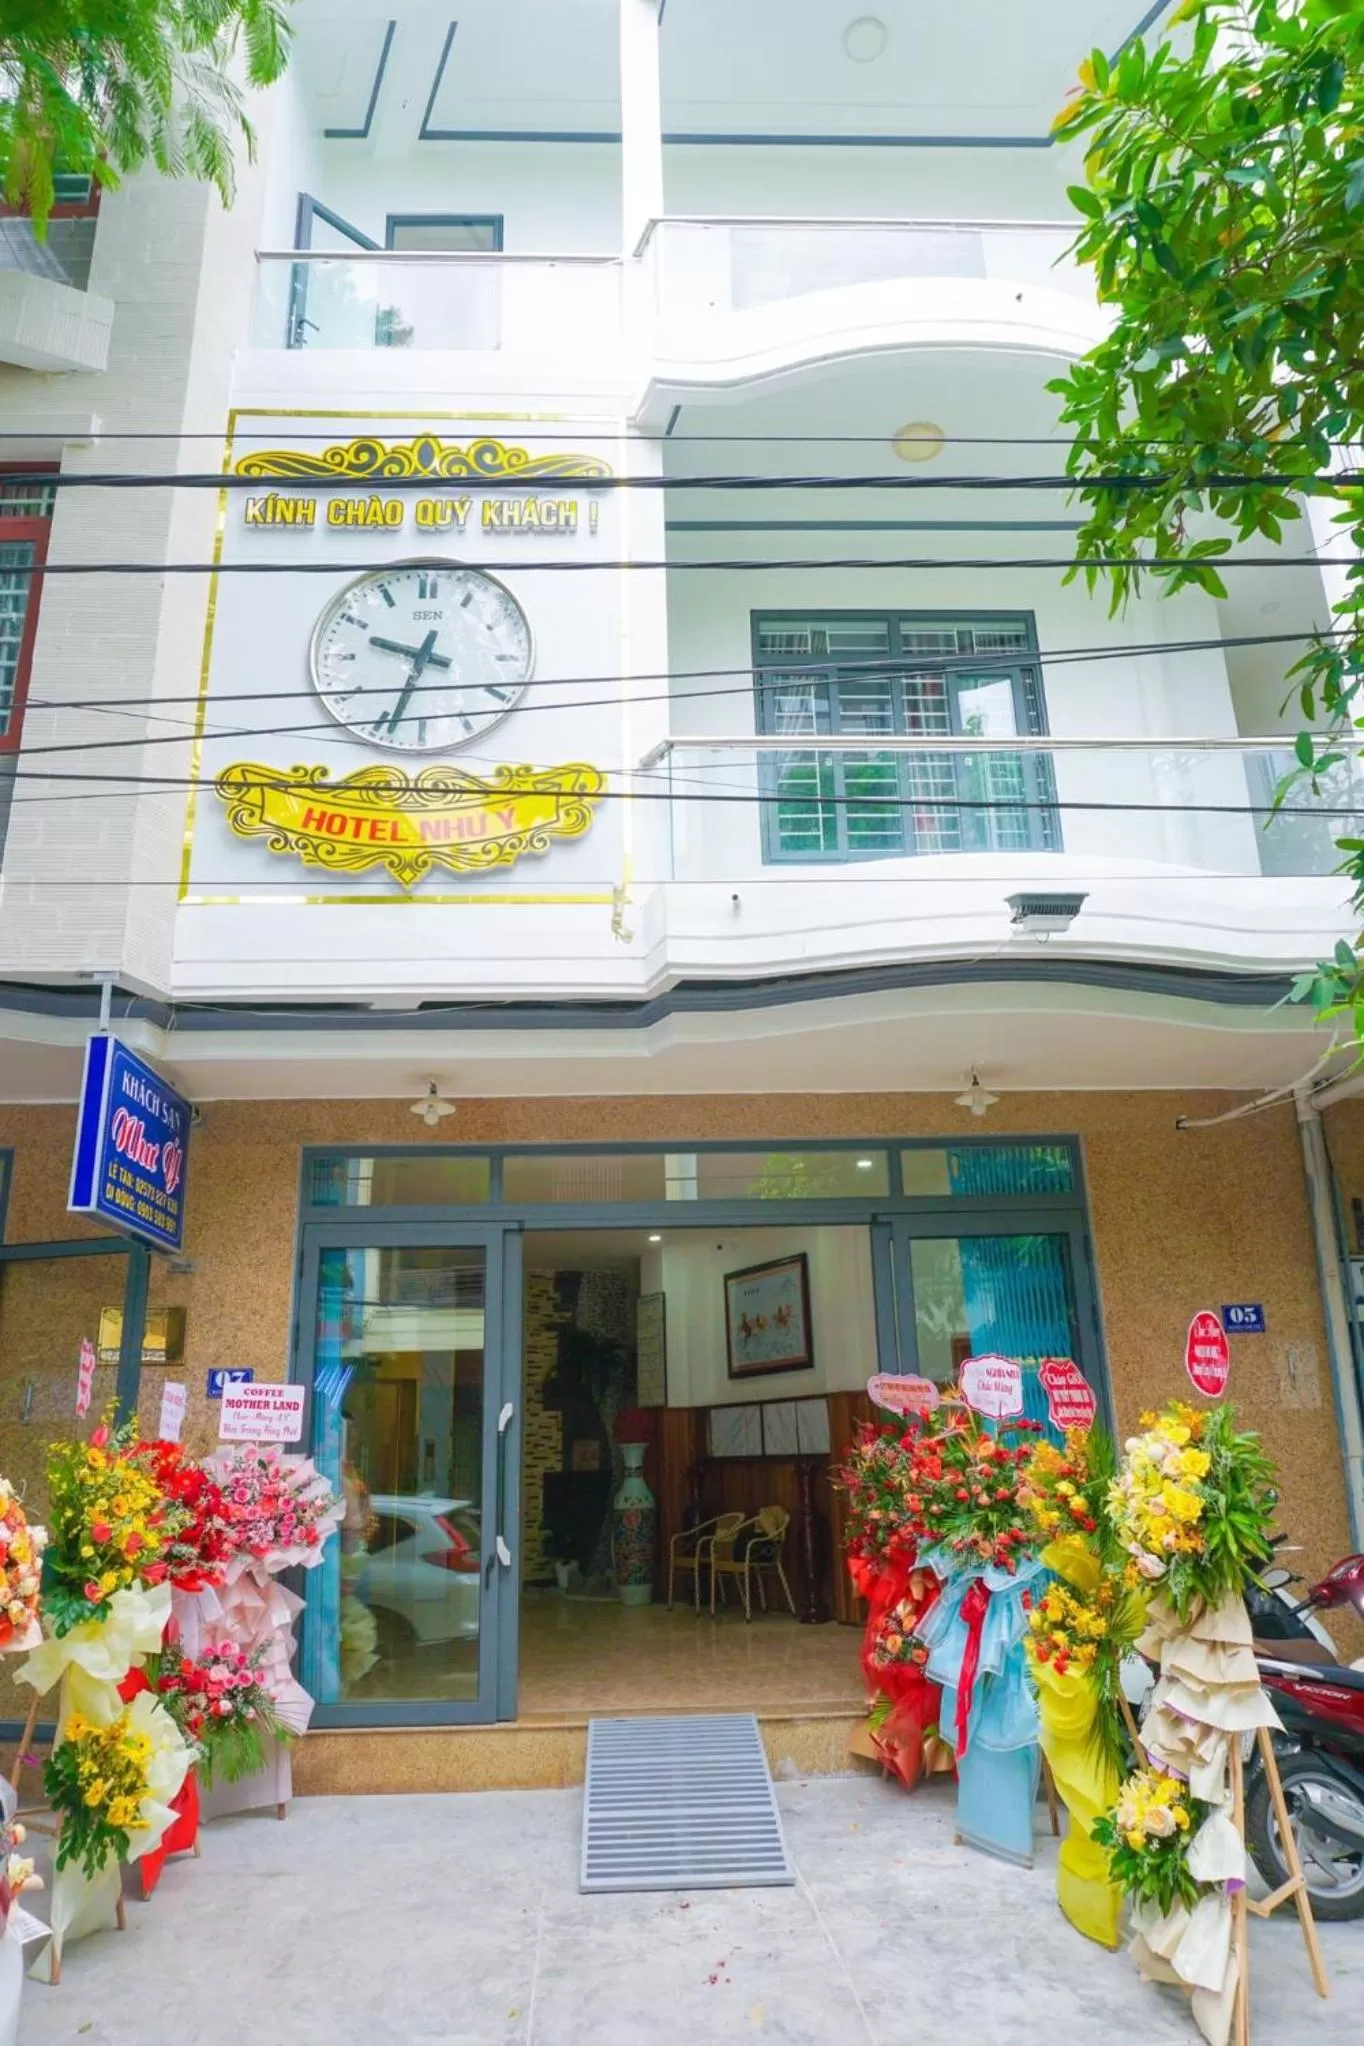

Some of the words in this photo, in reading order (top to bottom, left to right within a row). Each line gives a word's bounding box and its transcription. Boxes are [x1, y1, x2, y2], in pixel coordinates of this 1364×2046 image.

[245, 492, 317, 526] KÍNH
[327, 494, 404, 526] CHÀO
[416, 495, 473, 527] QUÝ
[481, 495, 577, 527] KHÁCH
[301, 806, 409, 842] HOTEL
[122, 1069, 160, 1117] KHÁCH
[1229, 1307, 1257, 1324] 05
[225, 1399, 271, 1410] MOTHER
[273, 1400, 300, 1411] LAND
[243, 1388, 285, 1398] COFFEE
